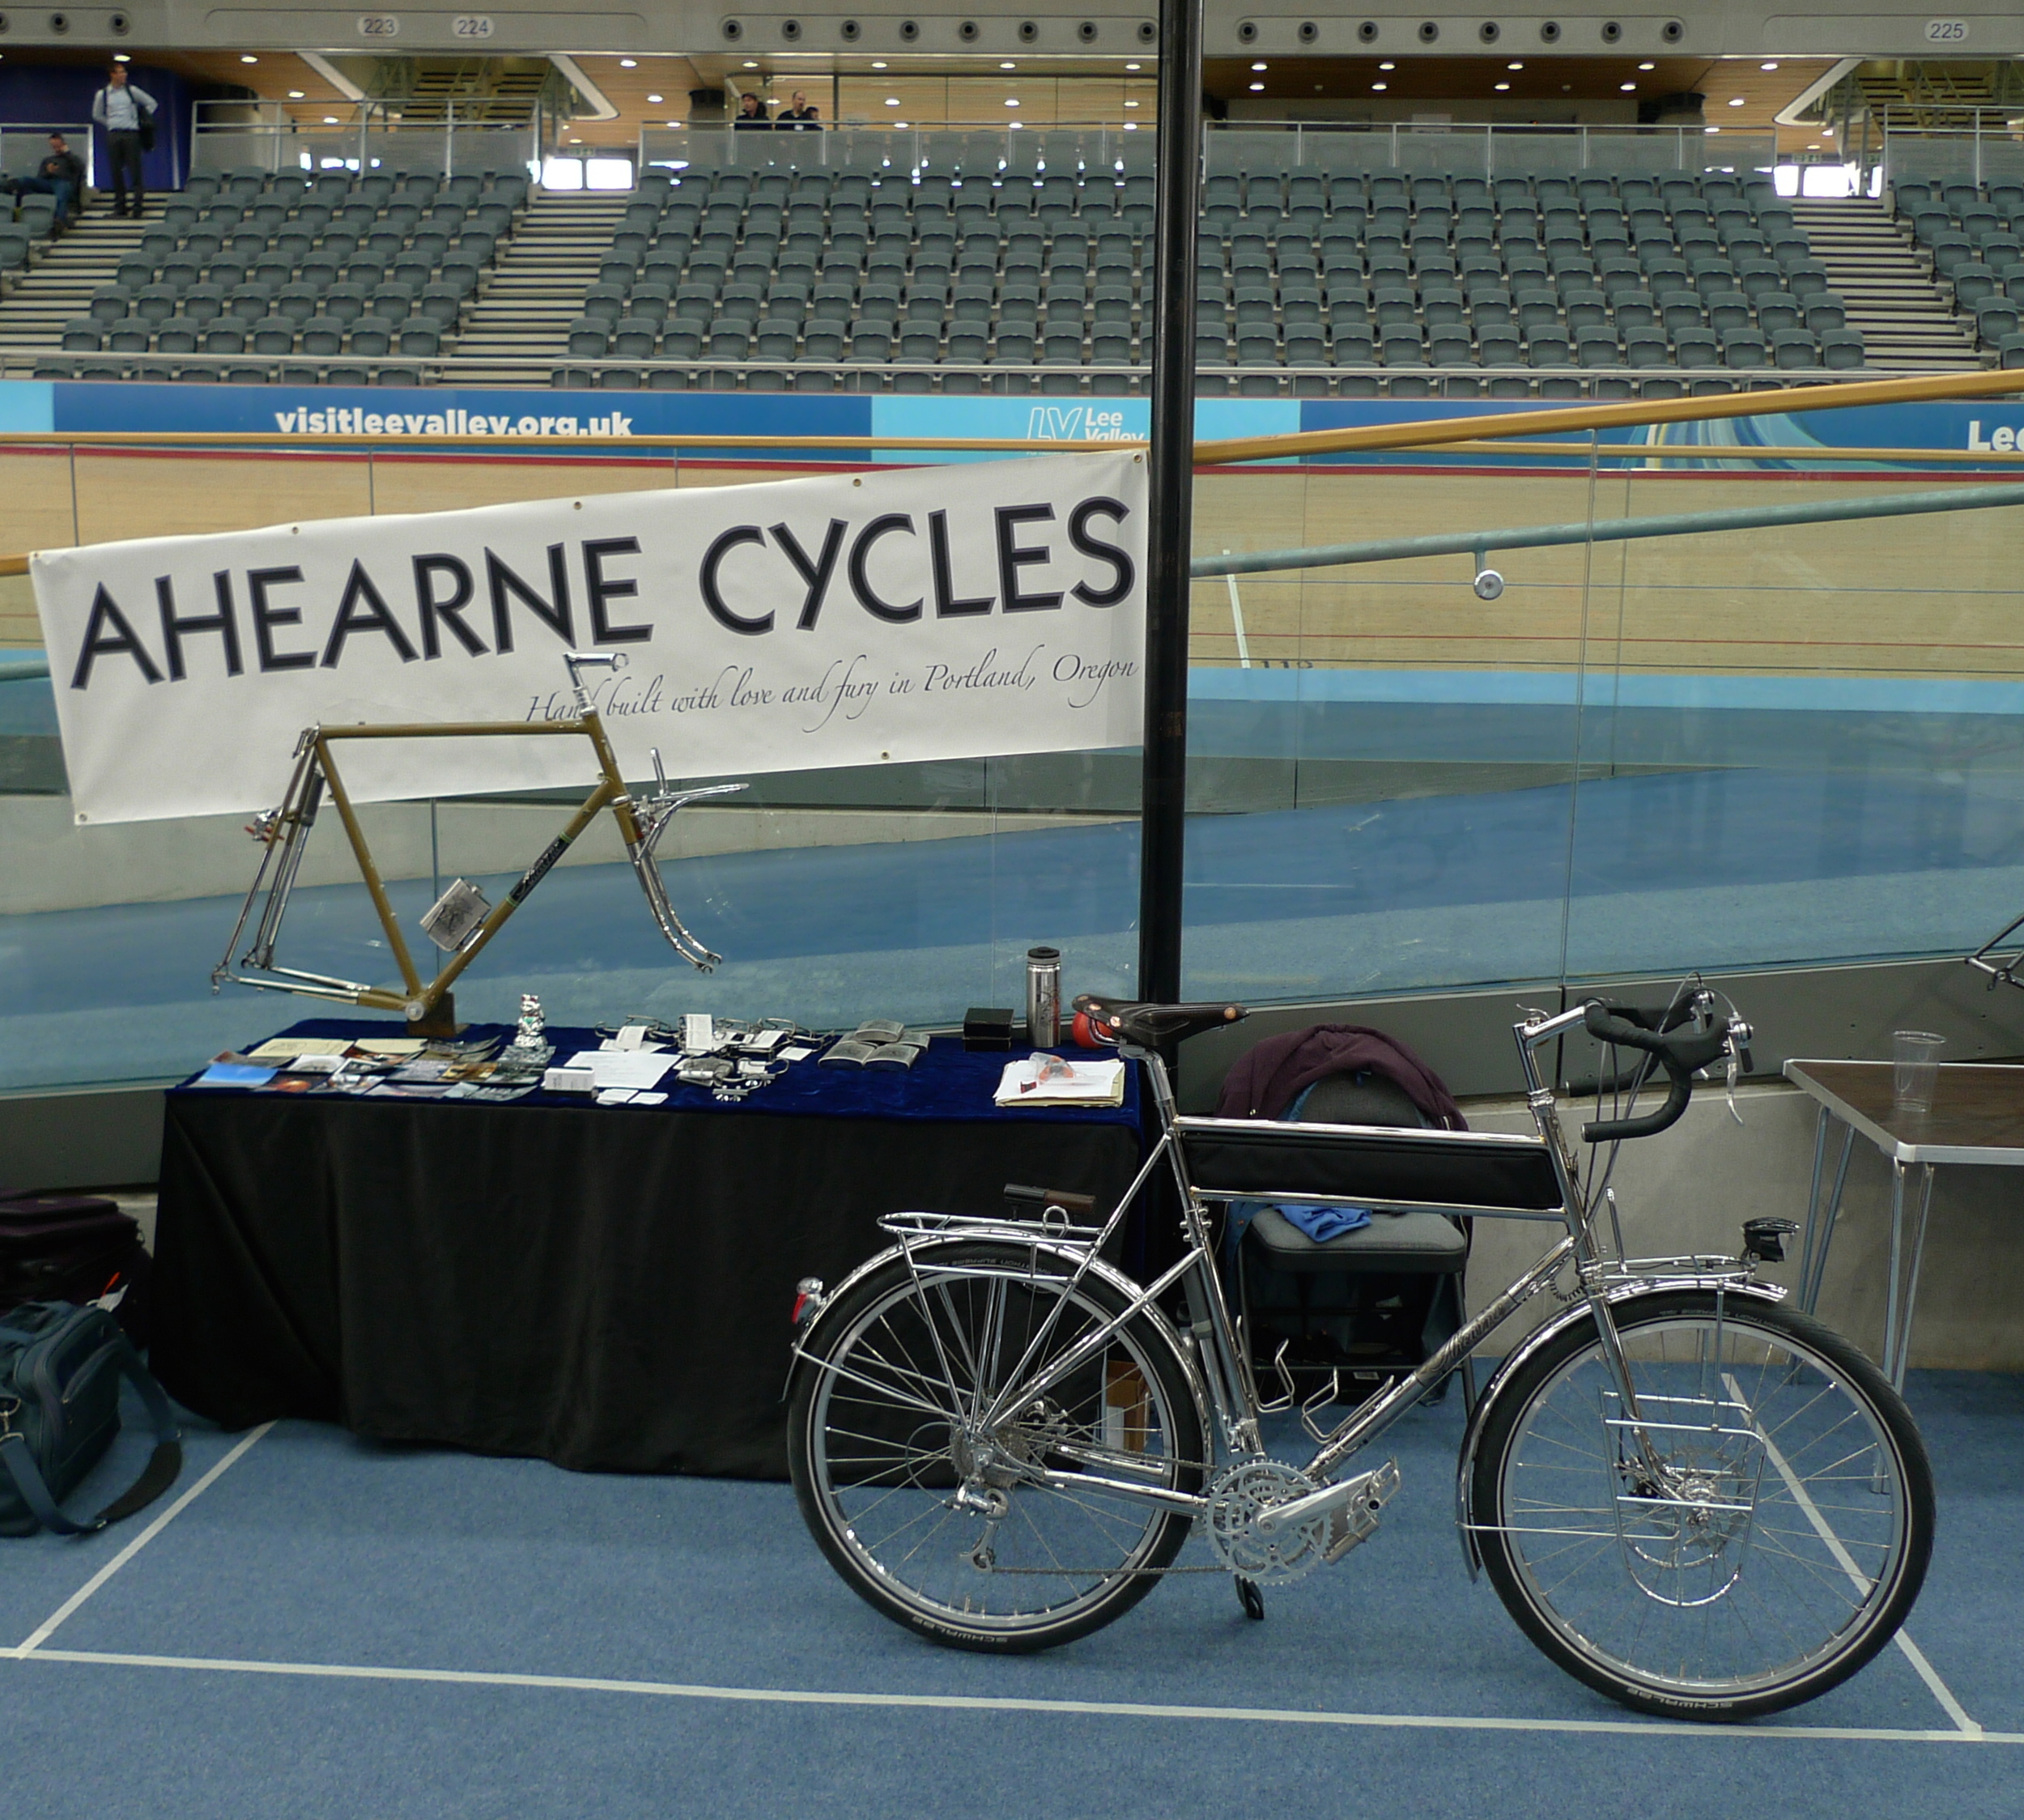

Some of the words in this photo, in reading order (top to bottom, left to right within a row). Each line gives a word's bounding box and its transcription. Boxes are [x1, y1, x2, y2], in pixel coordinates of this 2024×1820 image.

[364, 18, 395, 34] 223
[457, 19, 489, 34] 224
[1930, 23, 1964, 39] 225
[274, 406, 633, 436] visitleevalley.org.uk
[1085, 407, 1124, 427] Lee
[70, 536, 653, 691] AHEARNE
[699, 495, 1135, 636] CYCLES
[782, 660, 844, 704] and
[889, 672, 916, 695] in
[924, 644, 1045, 692] Portland,
[1052, 654, 1140, 708] Oregon
[606, 674, 665, 717] built
[671, 665, 738, 712] with
[730, 667, 776, 708] love
[802, 654, 879, 734] fury
[912, 1615, 1008, 1643] SCHWALBE
[1626, 1686, 1734, 1709] SCHWALBE
